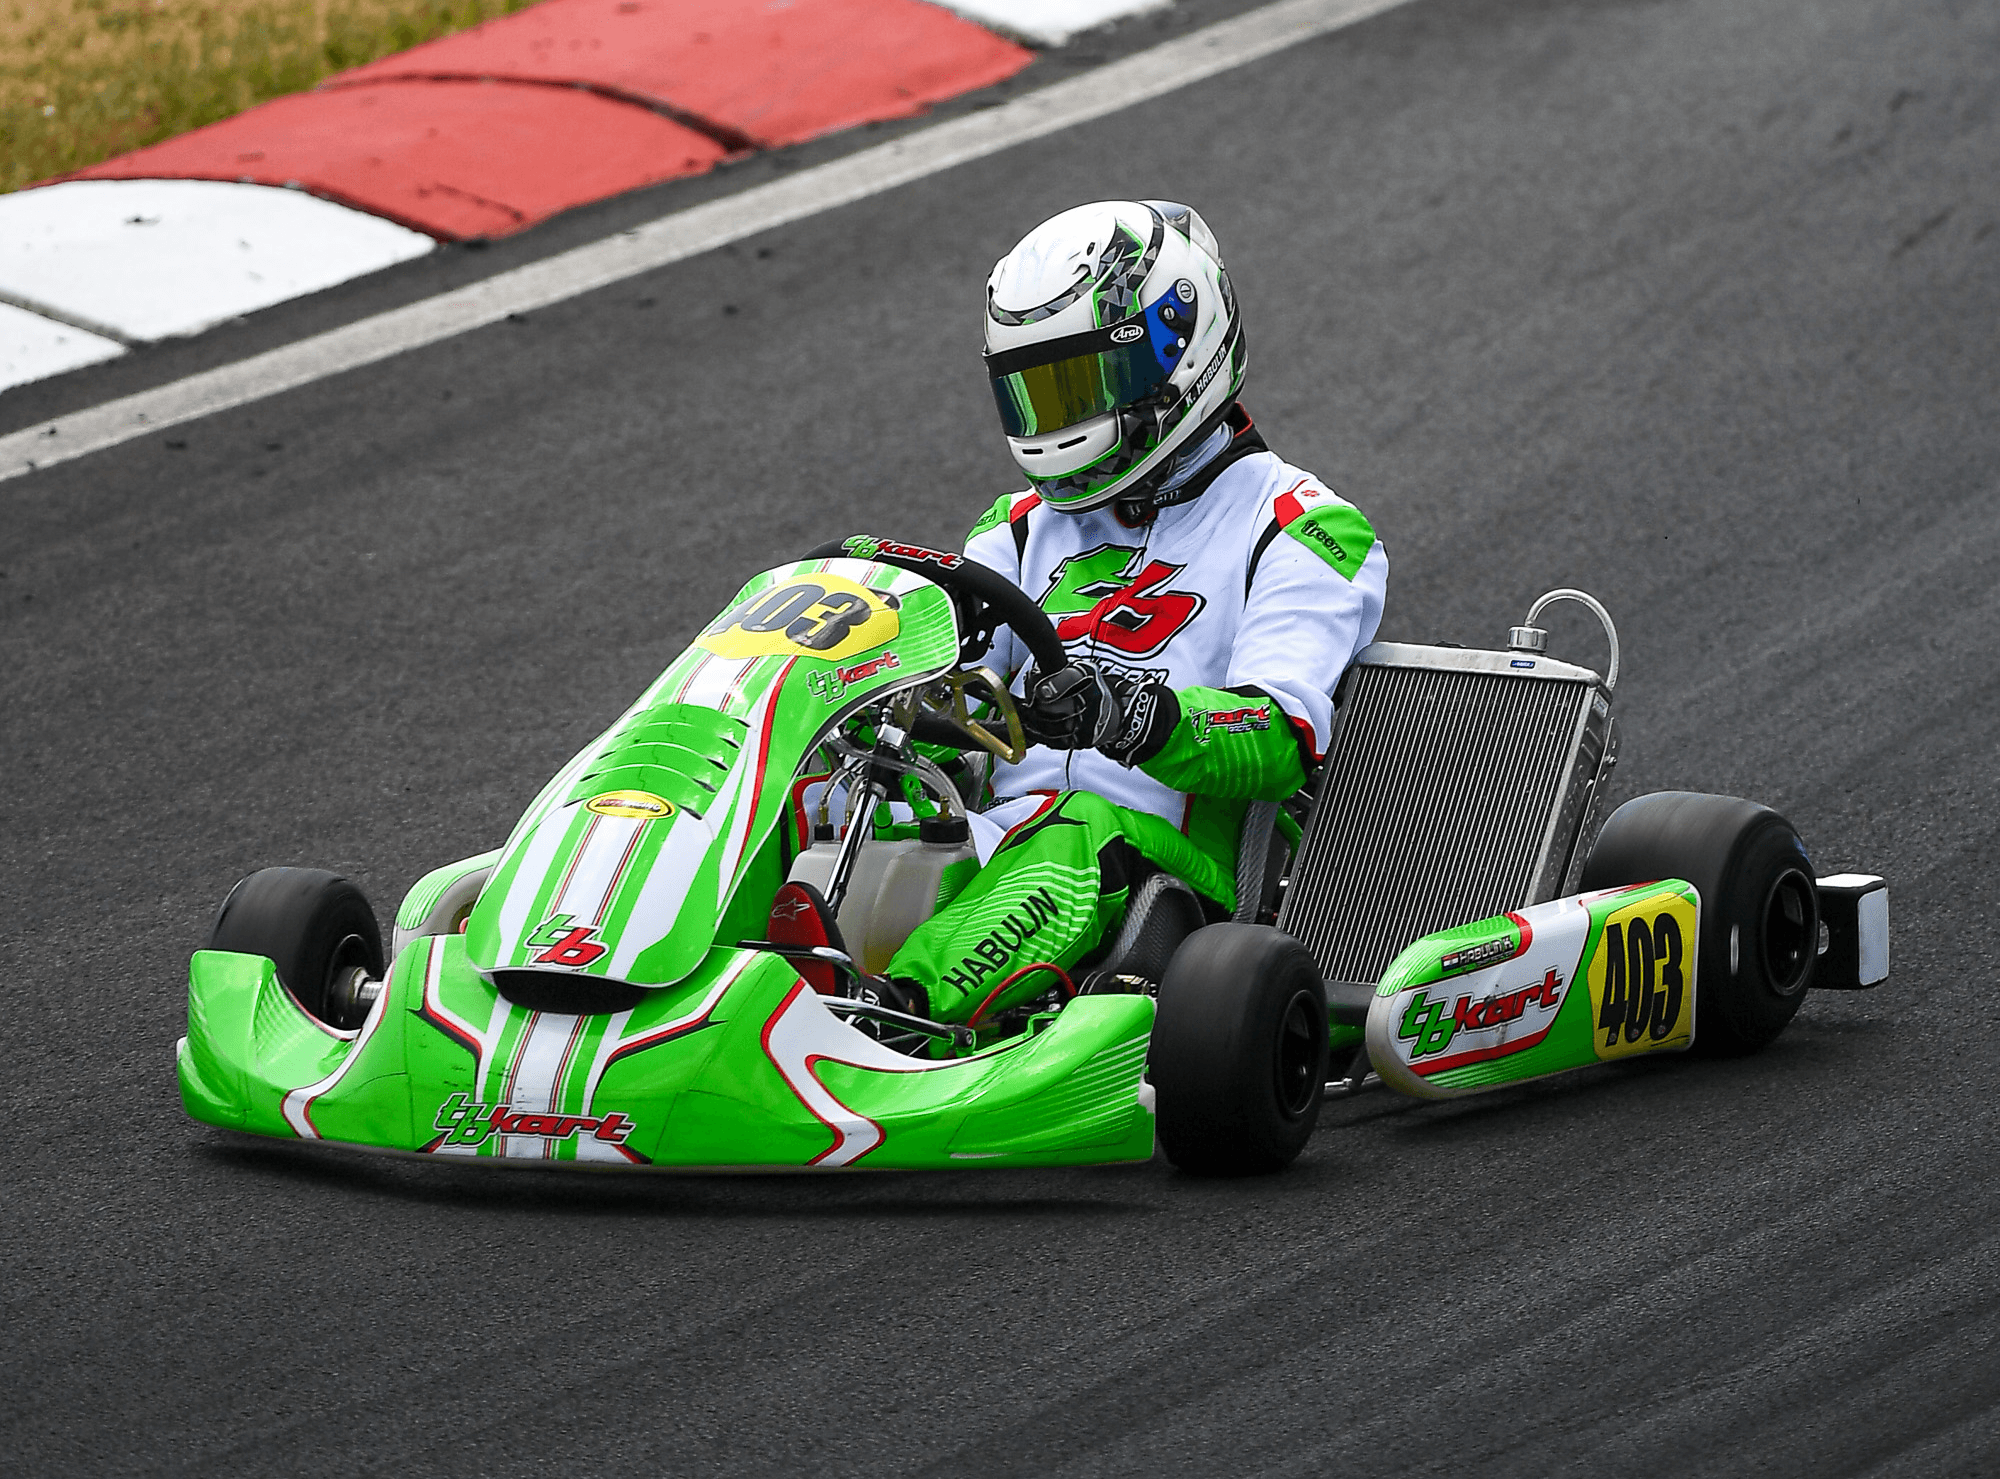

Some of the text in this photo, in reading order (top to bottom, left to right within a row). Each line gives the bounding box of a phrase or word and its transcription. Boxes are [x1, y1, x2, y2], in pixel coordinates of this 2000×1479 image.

[1113, 327, 1141, 341] Arai
[1196, 343, 1228, 395] HABULIN
[1301, 519, 1347, 561] freem
[806, 651, 900, 705] tbkart
[524, 913, 610, 968] tb
[942, 887, 1059, 997] HABULIN
[1597, 912, 1684, 1048] 403
[1398, 964, 1566, 1060] tbkart
[433, 1092, 637, 1149] tbkart
